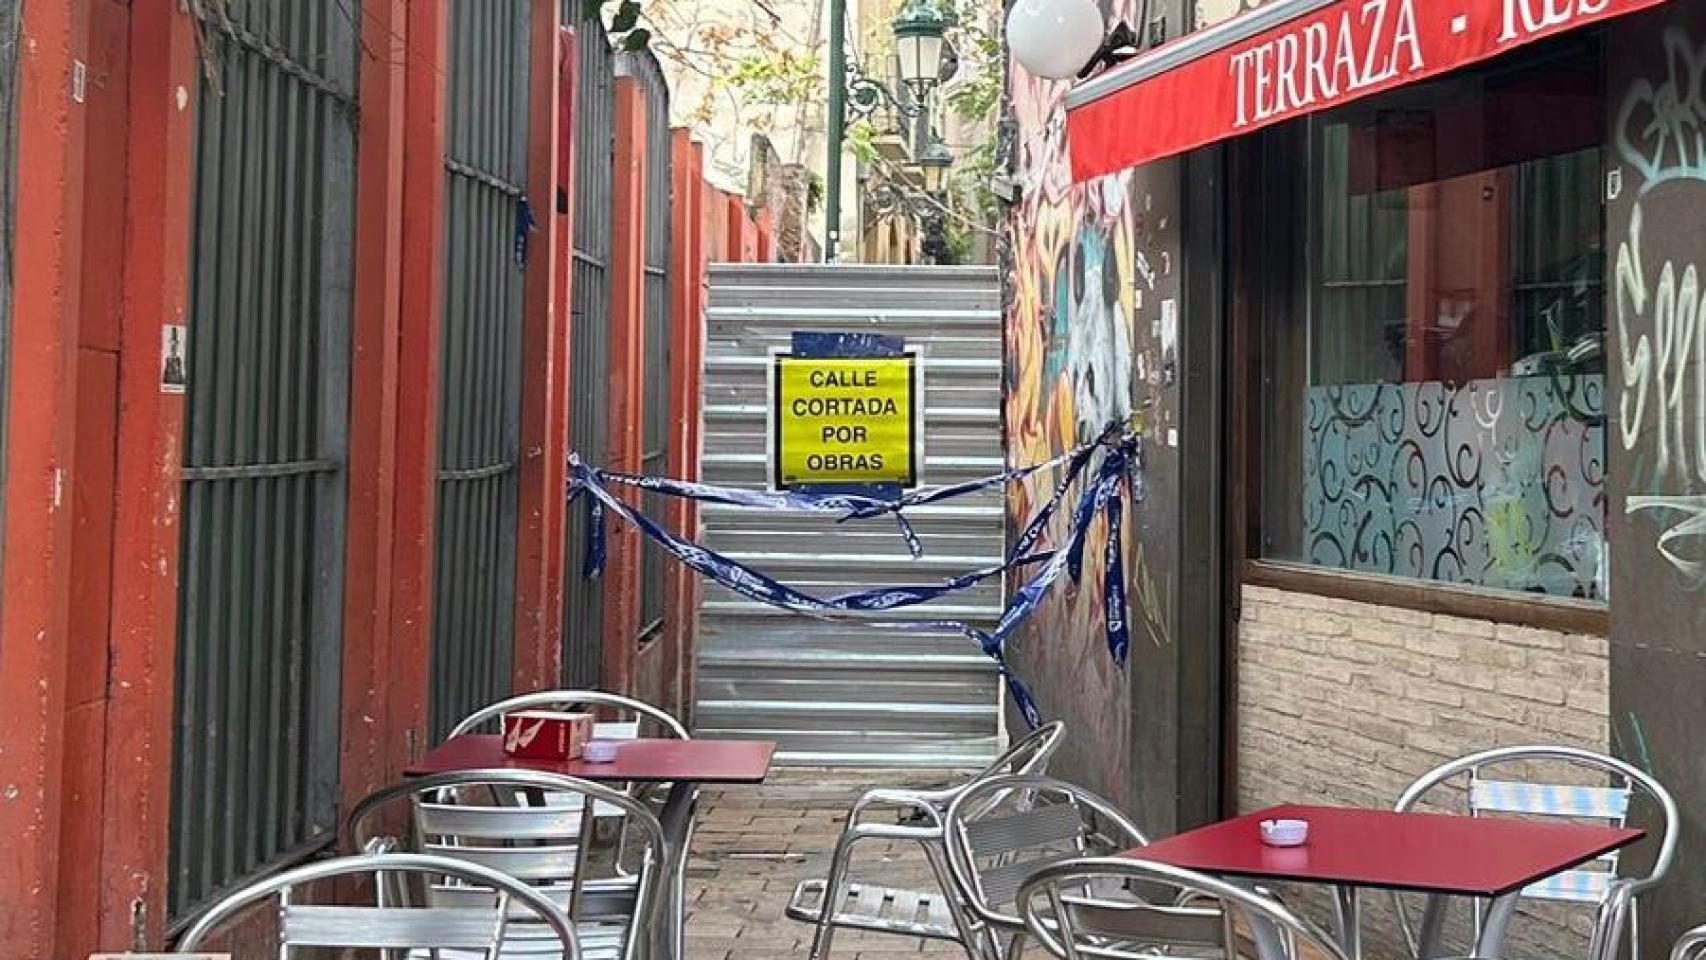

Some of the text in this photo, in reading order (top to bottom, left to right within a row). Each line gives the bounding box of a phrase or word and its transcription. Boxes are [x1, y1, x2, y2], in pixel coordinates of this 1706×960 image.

[1229, 0, 1424, 128] TERRAZA
[809, 370, 877, 388] CALLE
[792, 397, 897, 417] CORTADA
[822, 425, 867, 443] POR
[806, 453, 884, 471] OBRAS
